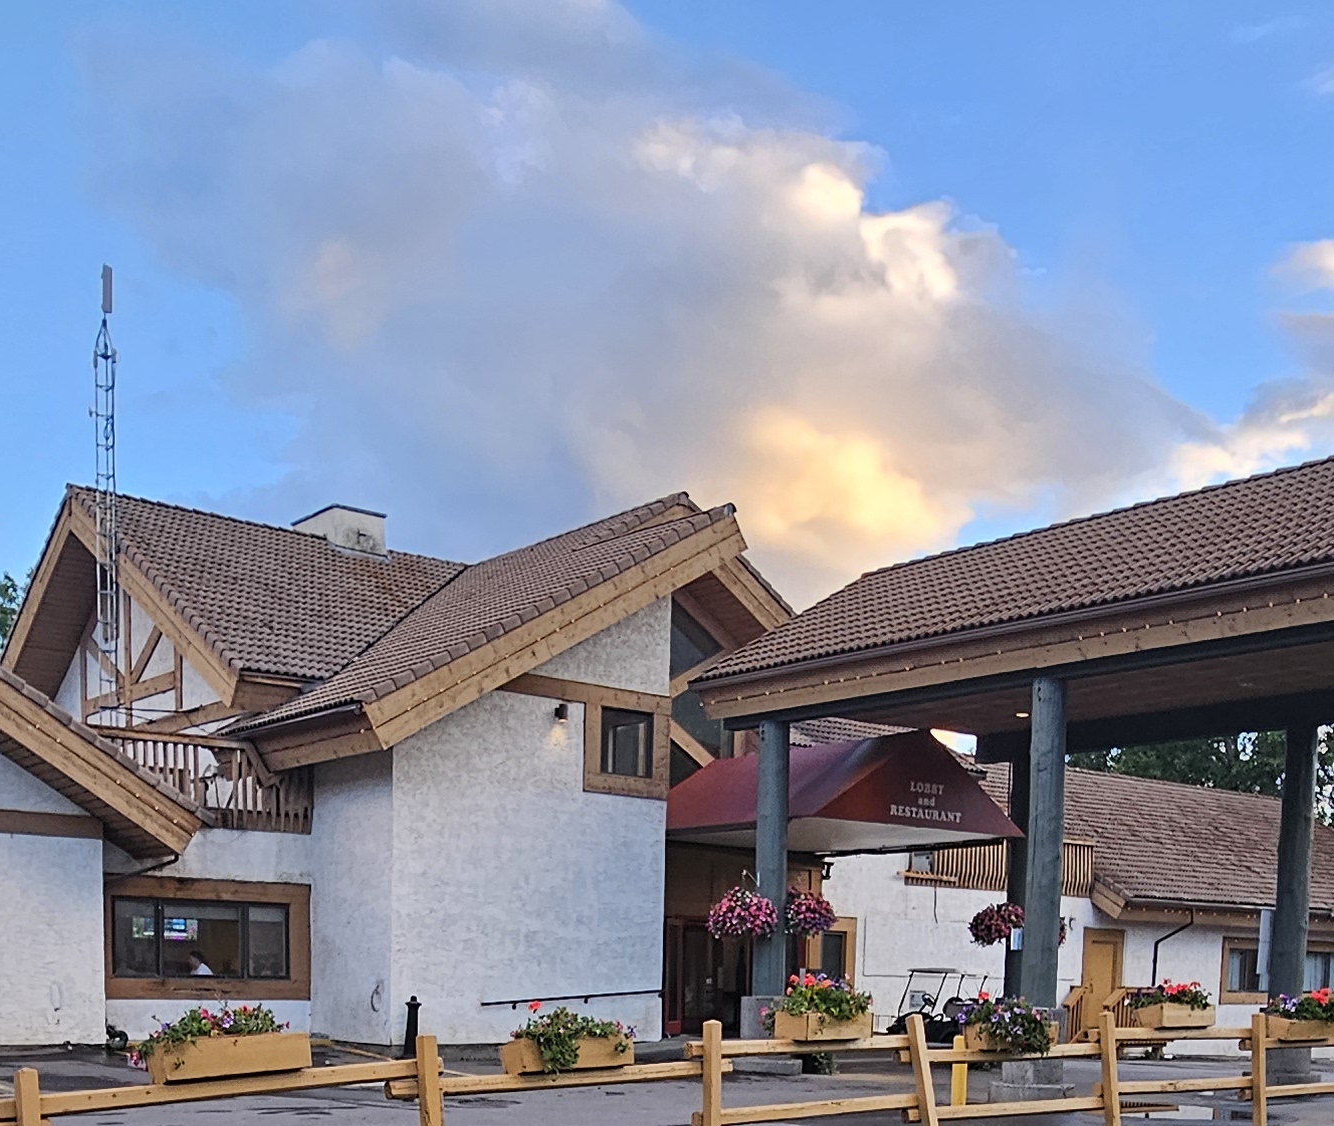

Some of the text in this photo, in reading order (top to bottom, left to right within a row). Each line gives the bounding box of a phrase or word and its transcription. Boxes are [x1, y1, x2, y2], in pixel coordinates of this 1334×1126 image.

[910, 781, 944, 795] LOBBY
[918, 797, 935, 807] and
[890, 804, 961, 823] RESTAURANT
